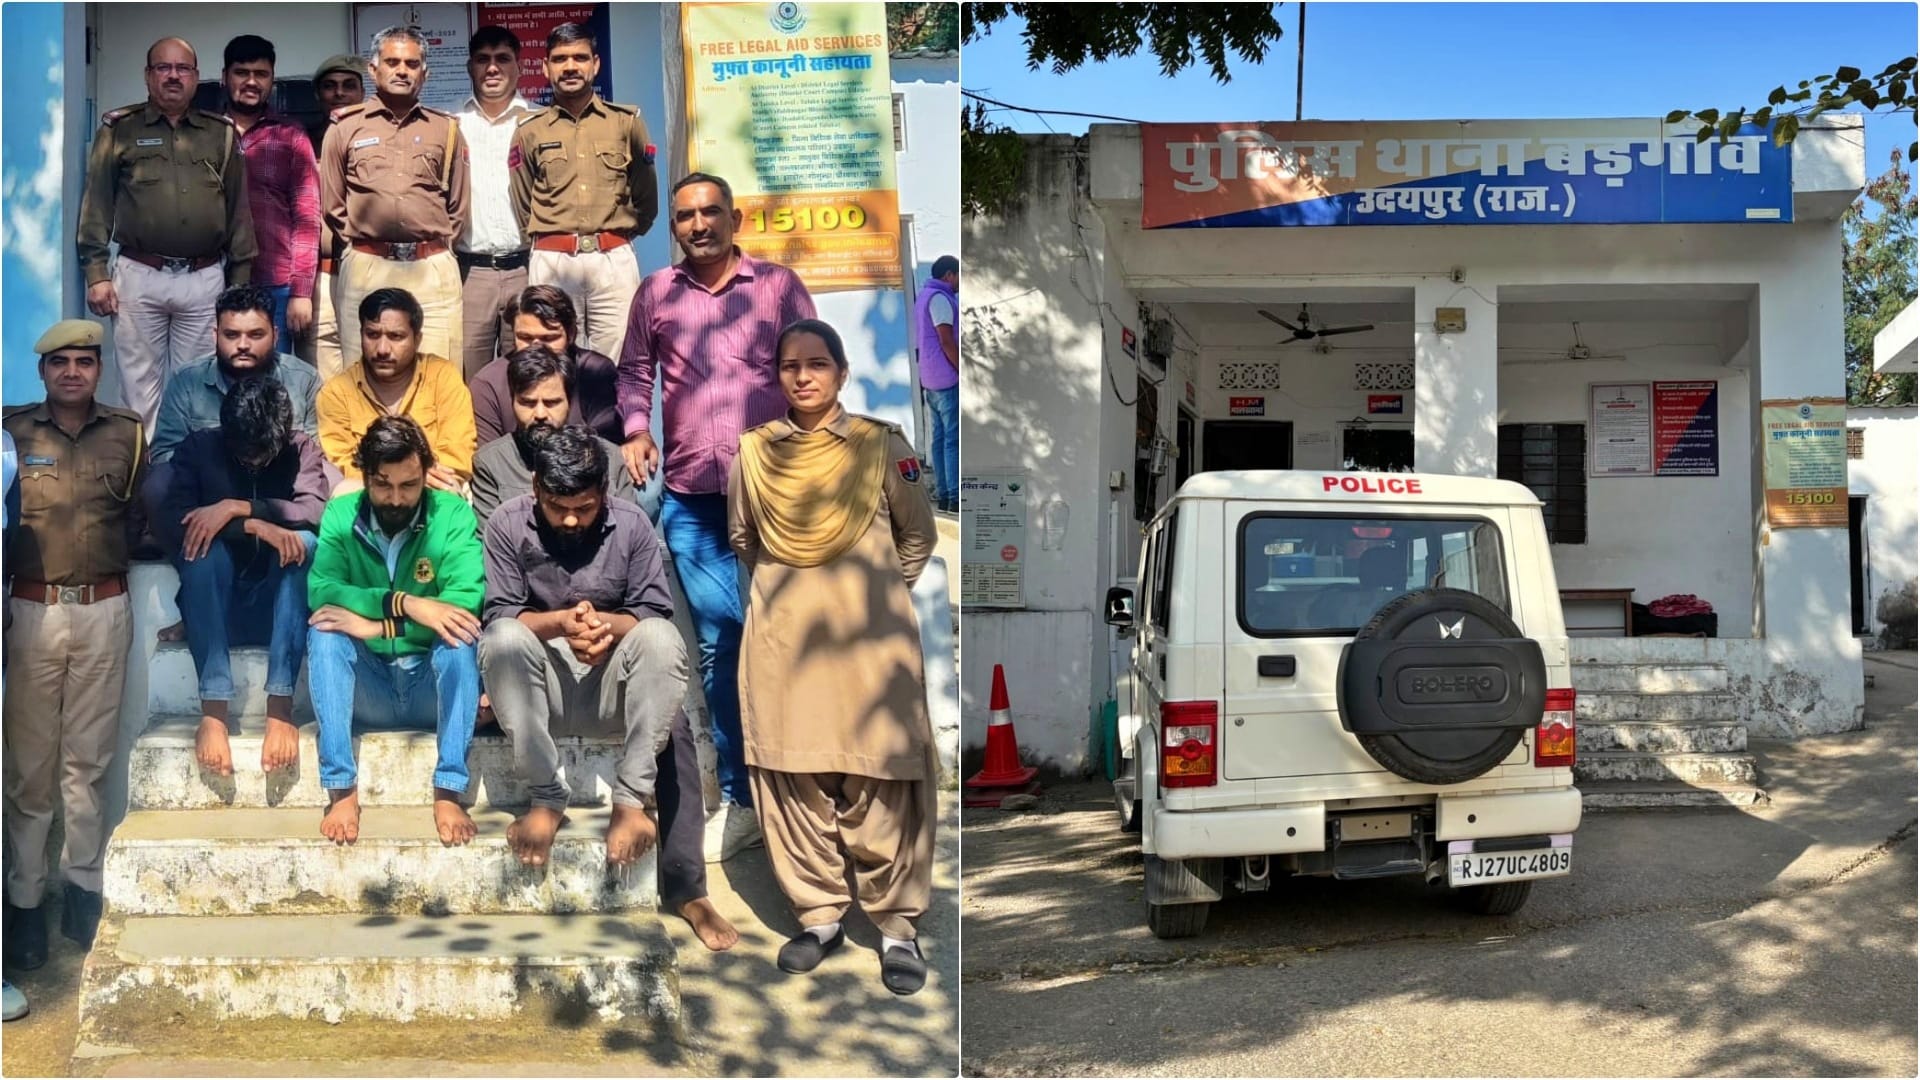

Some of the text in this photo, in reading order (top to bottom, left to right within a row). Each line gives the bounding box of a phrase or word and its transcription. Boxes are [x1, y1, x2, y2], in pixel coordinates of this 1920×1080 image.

[700, 34, 882, 56] FREE LEGAL AID SERVICES
[751, 54, 806, 79] कानूनी
[809, 54, 872, 72] सहायता
[1166, 130, 1364, 193] पुलिस
[1376, 138, 1532, 177] थाना
[1355, 183, 1576, 219] उदयपुर (राज.)
[751, 205, 866, 232] 15100
[1322, 476, 1423, 494] POLICE
[1786, 493, 1835, 505] 15100
[1412, 673, 1493, 699] BOLERO
[1462, 851, 1569, 878] RJ27UC4809
